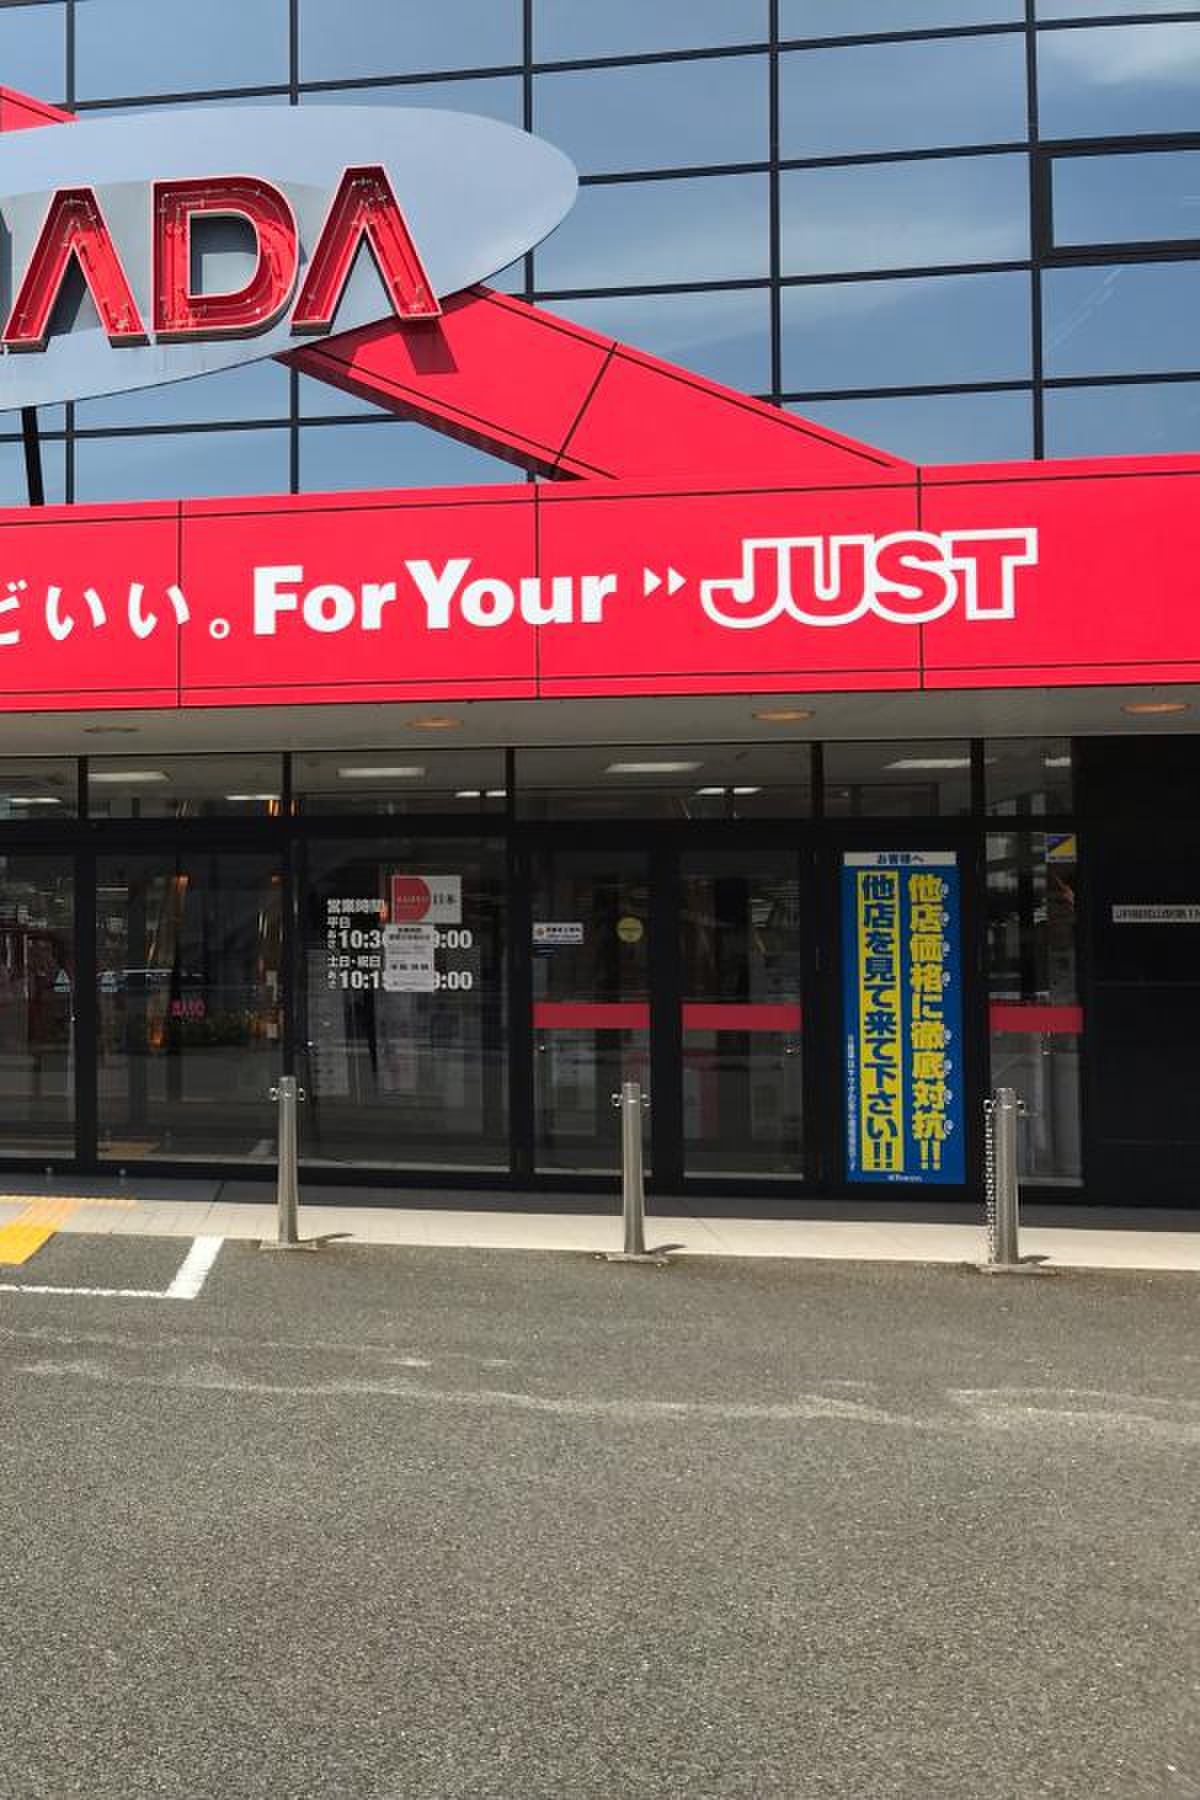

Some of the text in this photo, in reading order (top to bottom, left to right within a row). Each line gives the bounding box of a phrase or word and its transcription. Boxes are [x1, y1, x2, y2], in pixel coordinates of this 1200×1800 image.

[253, 526, 1039, 636] For Your JUST
